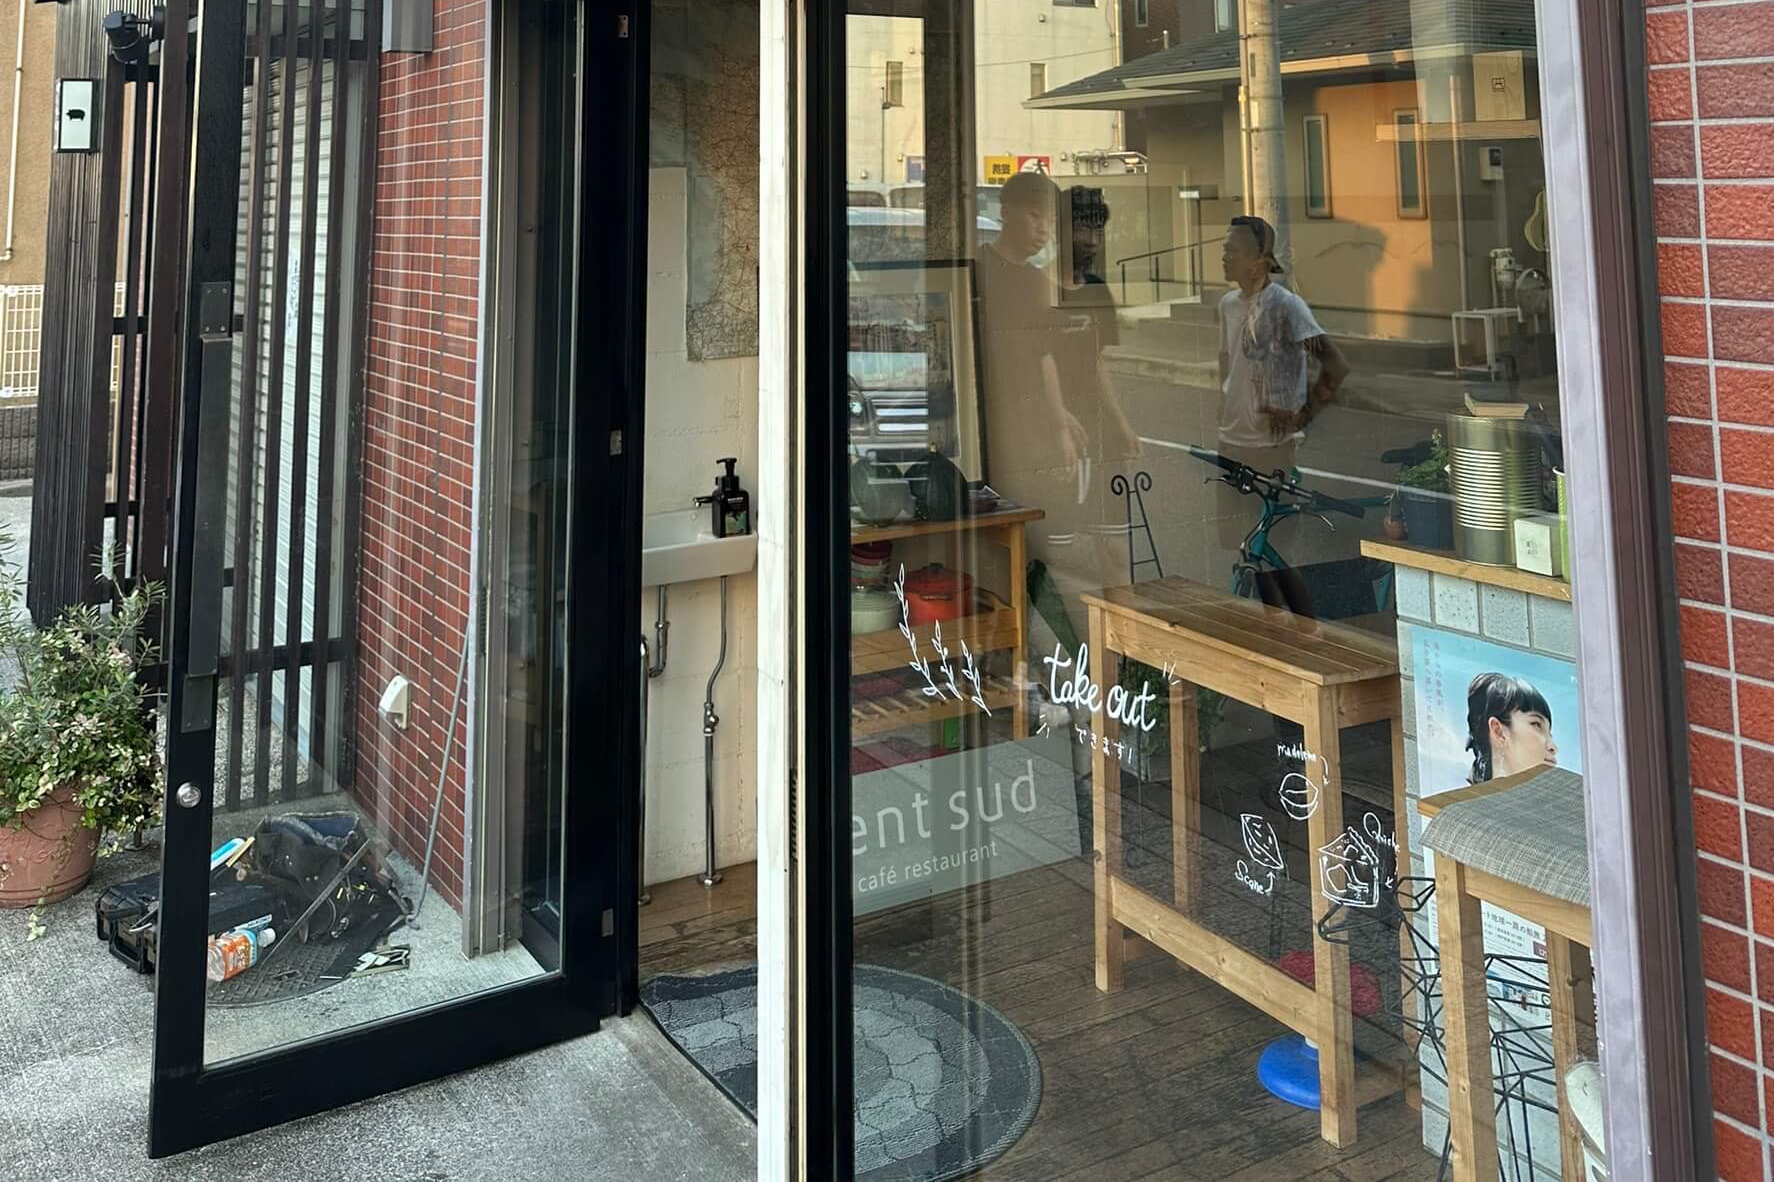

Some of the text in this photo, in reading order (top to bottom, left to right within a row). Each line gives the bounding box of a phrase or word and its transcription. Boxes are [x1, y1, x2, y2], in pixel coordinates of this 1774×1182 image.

[1043, 642, 1156, 732] take out
[949, 759, 1037, 831] sud
[858, 841, 998, 892] café restaurant
